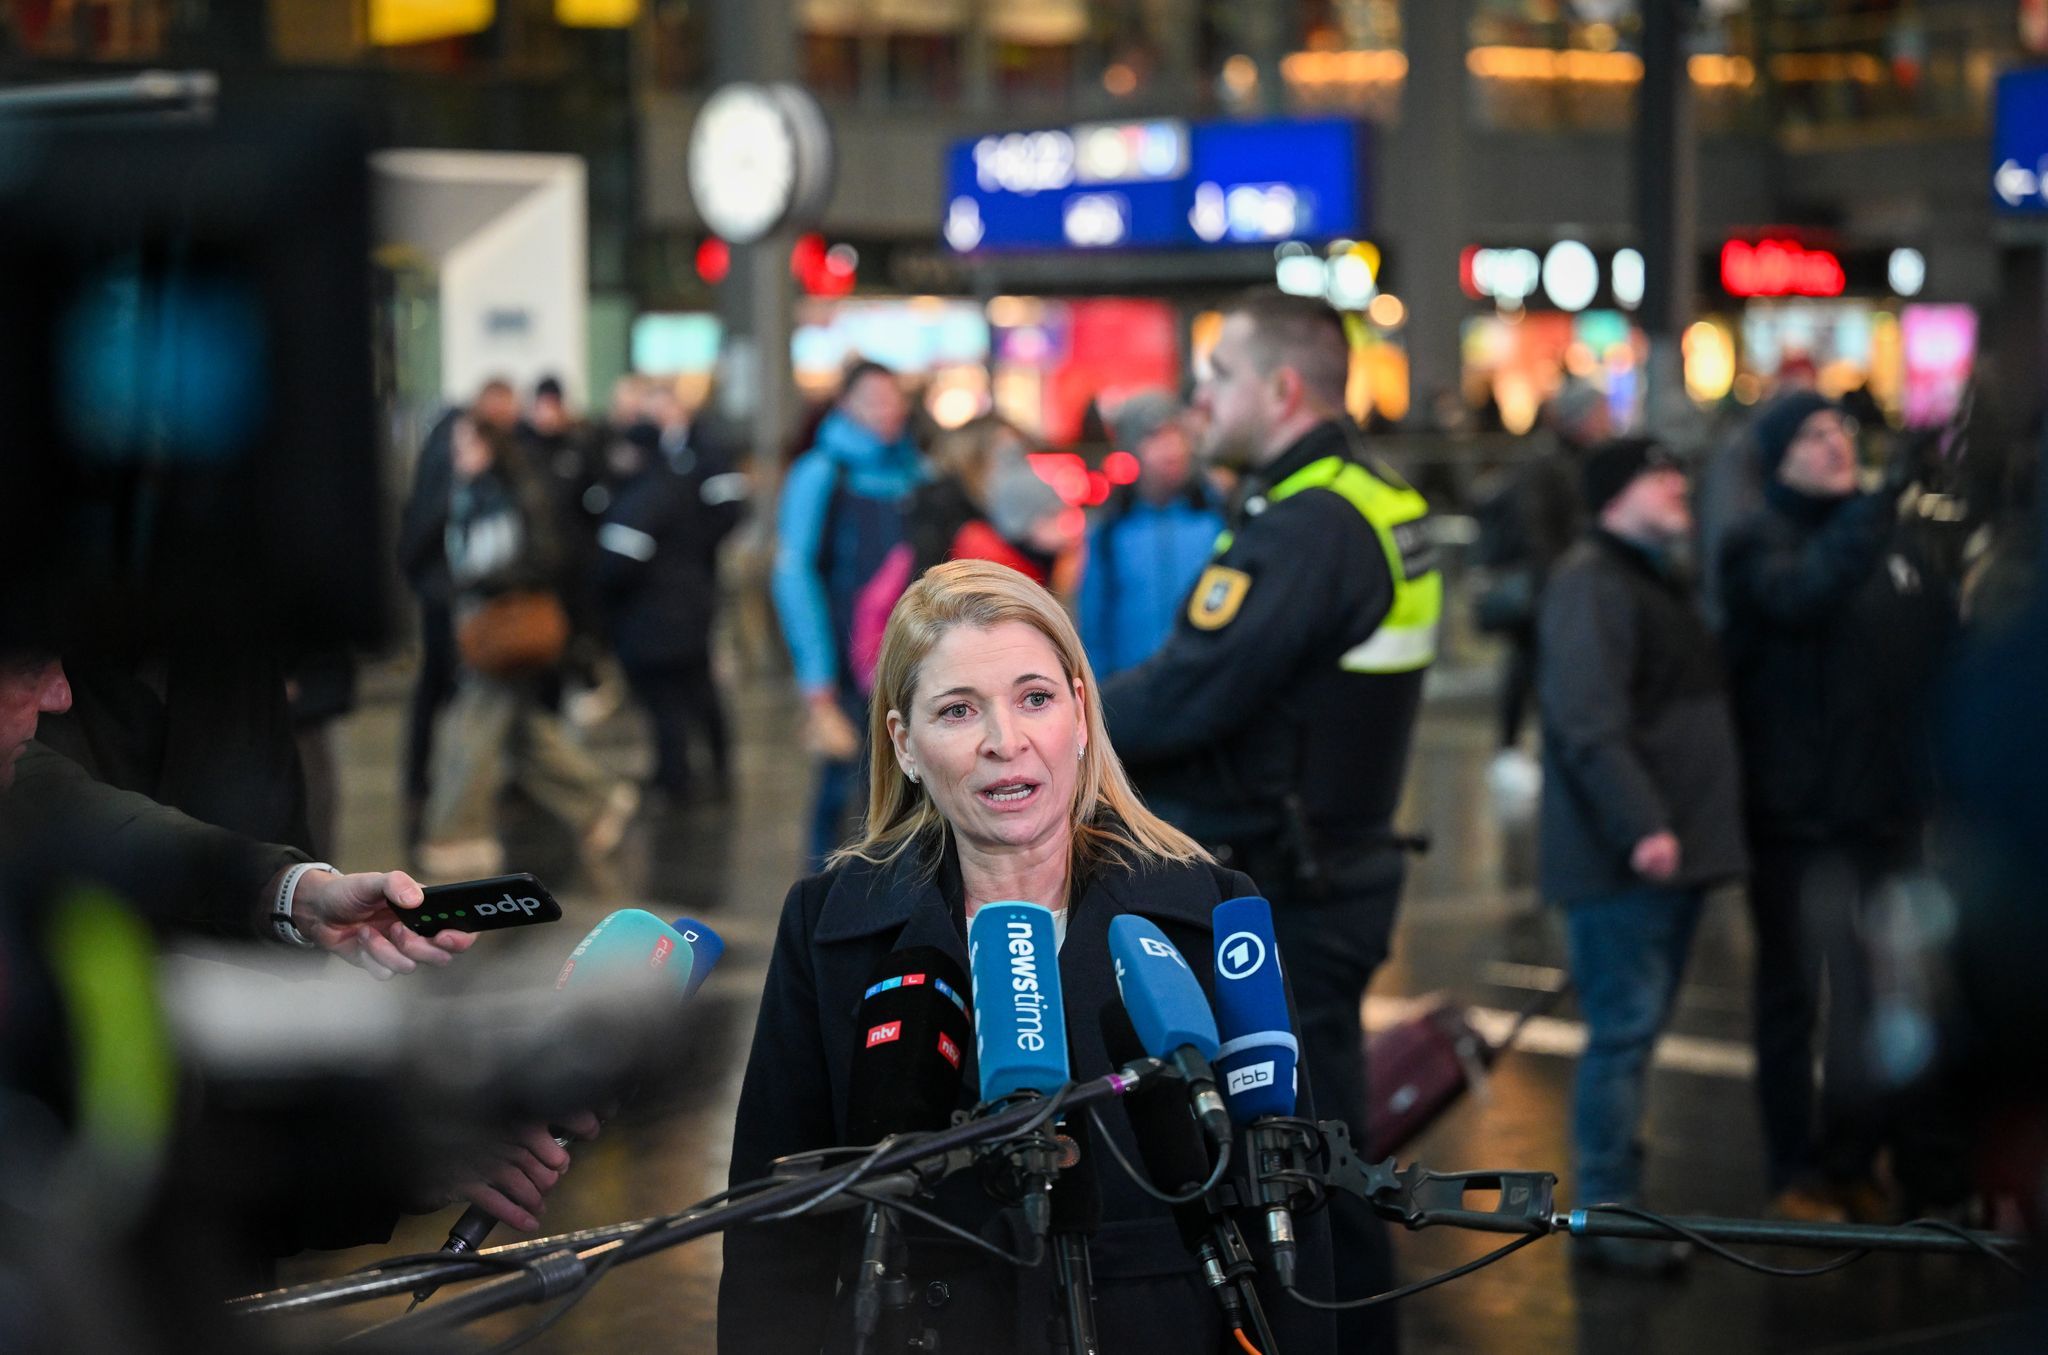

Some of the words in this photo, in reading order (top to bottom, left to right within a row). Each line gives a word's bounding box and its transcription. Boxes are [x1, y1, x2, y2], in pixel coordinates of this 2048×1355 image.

[474, 893, 540, 916] dpa
[1139, 937, 1186, 969] BR
[869, 1025, 898, 1044] ntv
[1230, 1066, 1270, 1091] rbb
